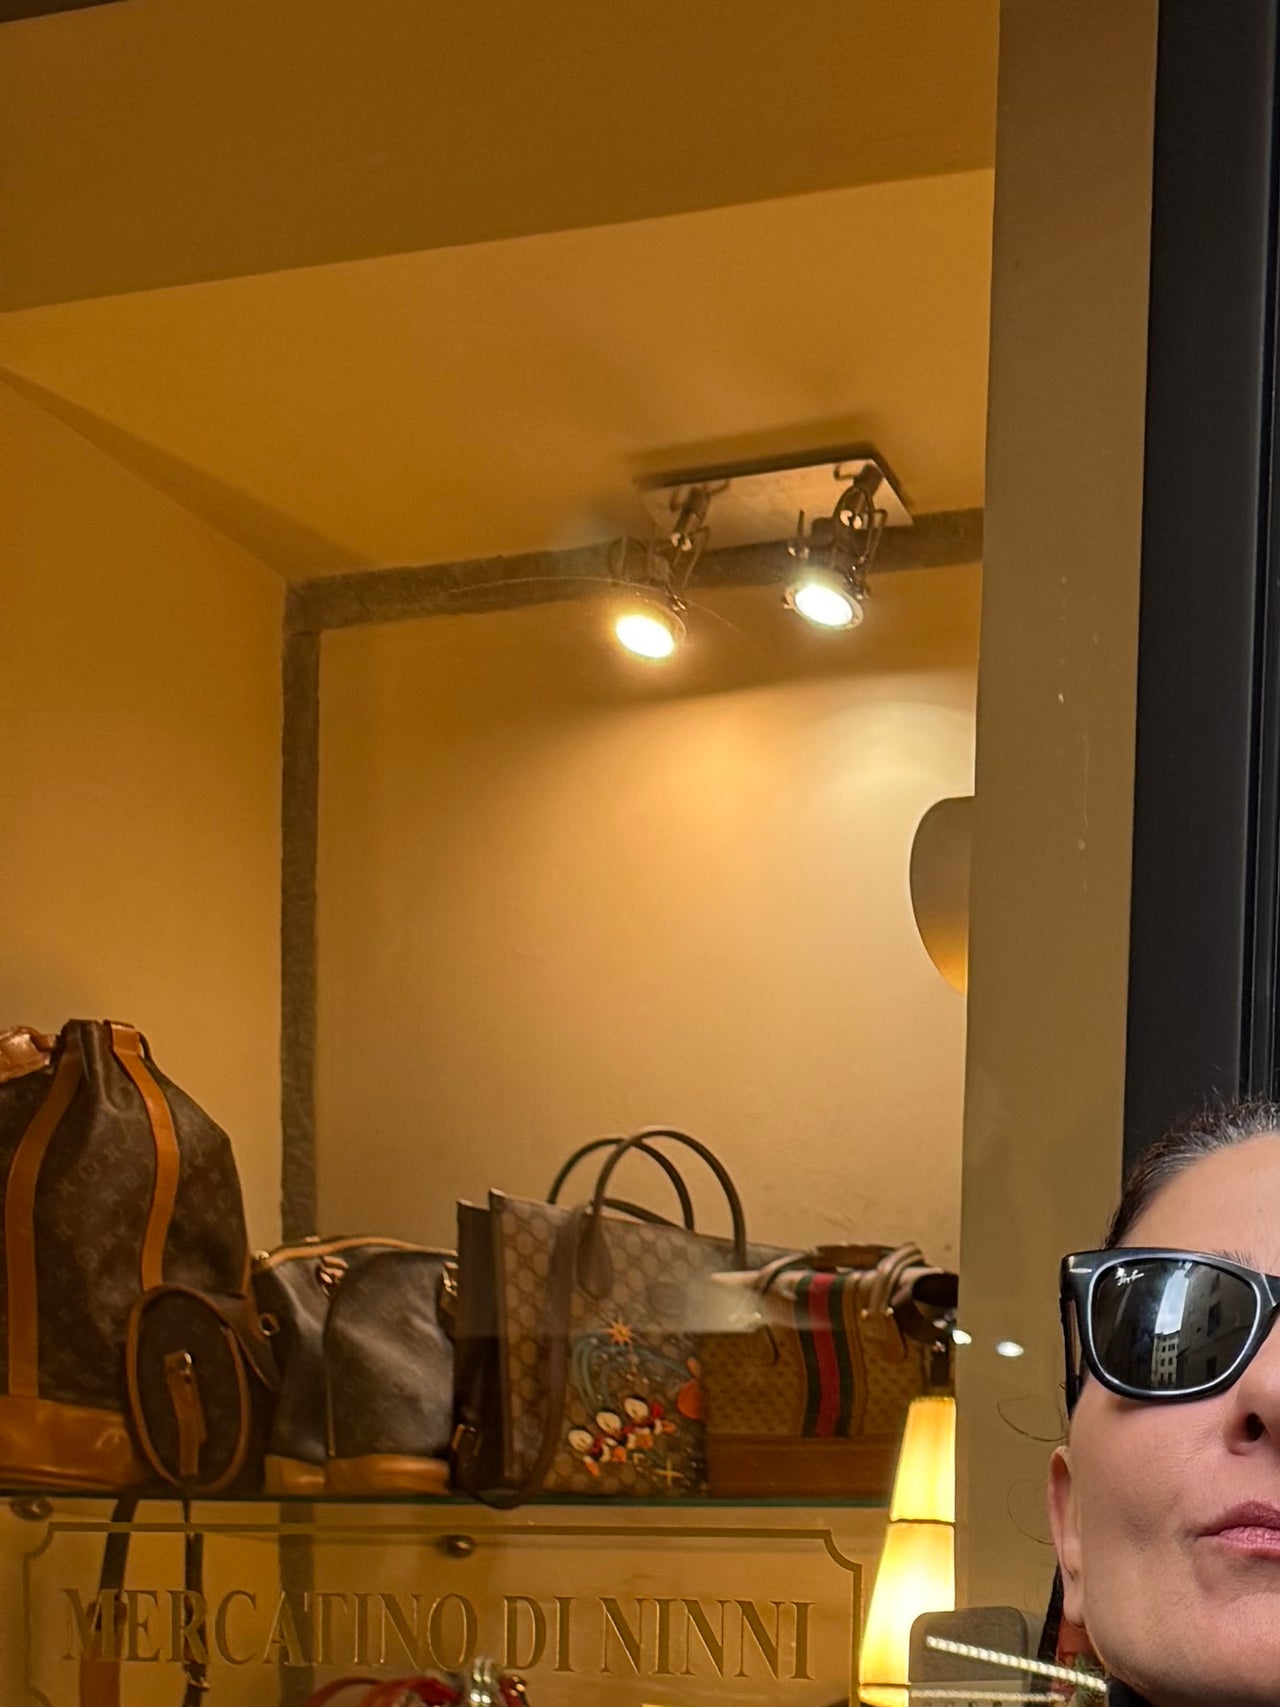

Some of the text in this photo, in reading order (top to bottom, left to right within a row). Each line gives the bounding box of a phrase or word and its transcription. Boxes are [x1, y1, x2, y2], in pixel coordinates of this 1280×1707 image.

[62, 1587, 818, 1682] MERCATINO DI NINNI
